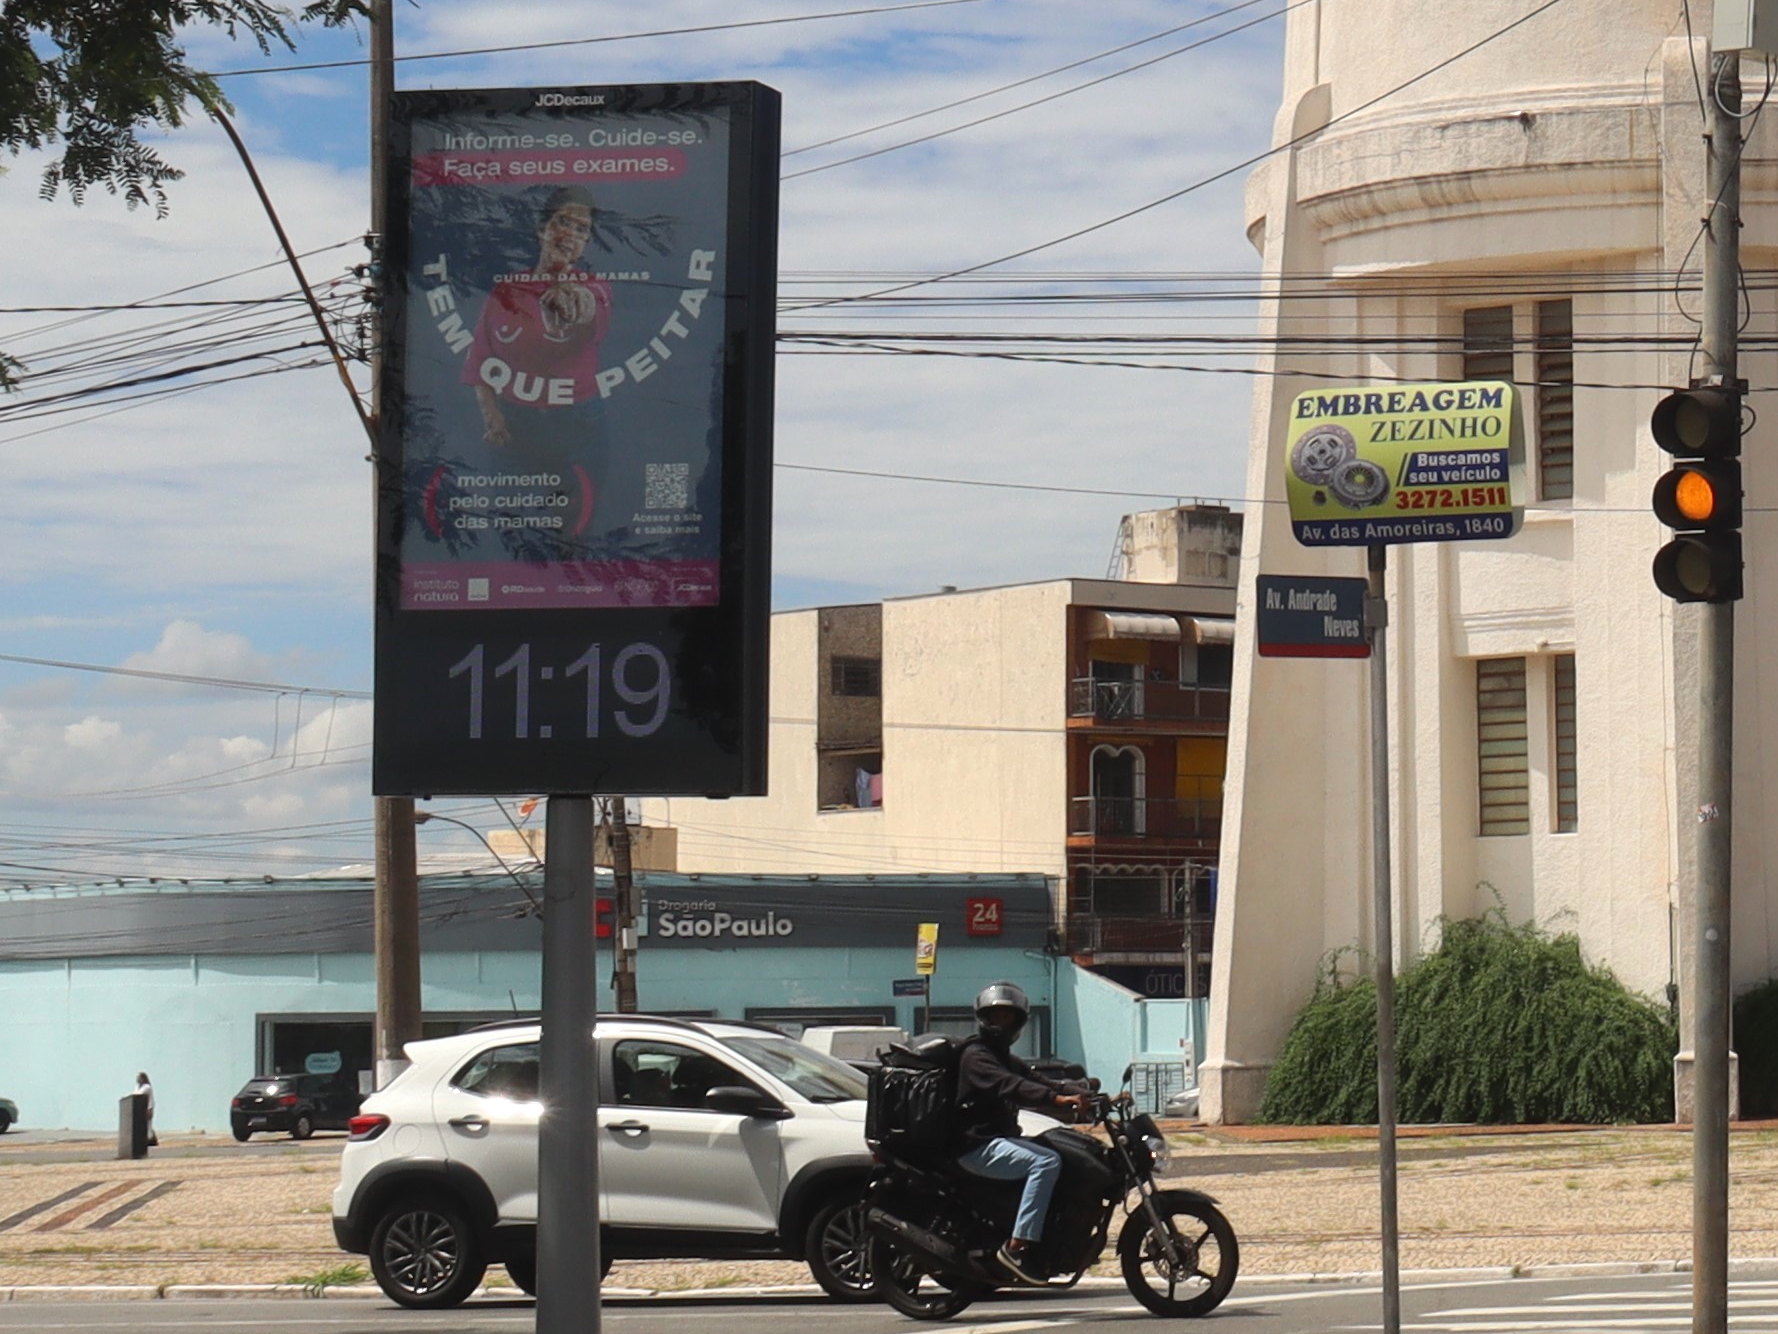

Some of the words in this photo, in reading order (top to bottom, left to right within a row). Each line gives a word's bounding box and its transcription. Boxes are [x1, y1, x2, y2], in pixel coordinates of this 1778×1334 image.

[534, 93, 605, 107] JCDecaux
[444, 132, 581, 151] Informe-se.
[588, 128, 703, 148] Cuide-se.
[443, 157, 501, 178] Faça
[508, 159, 565, 175] seus
[572, 156, 675, 174] exames.
[493, 272, 550, 284] CUIDAR
[557, 272, 589, 282] DAS
[595, 270, 651, 281] MAMAS
[422, 253, 476, 354] TEM
[479, 356, 575, 406] QUE
[595, 248, 717, 400] PEITAR
[1294, 387, 1505, 419] EMBREAGEM
[1369, 415, 1503, 443] ZEZINHO
[1417, 450, 1501, 467] Buscamos
[456, 472, 561, 488] movimento
[1409, 469, 1438, 483] seu
[1441, 465, 1501, 482] veículo
[448, 493, 490, 512] pelo
[494, 492, 570, 508] cuidado
[1394, 486, 1507, 510] 3272.1511
[454, 514, 490, 529] das
[494, 515, 564, 530] mamas
[1301, 525, 1326, 541] Av.
[1329, 524, 1360, 540] das
[1364, 519, 1461, 539] Amoreiras,
[1464, 518, 1504, 534] 1840
[1265, 587, 1285, 610] Av.
[1287, 588, 1338, 612] Andrade
[1323, 615, 1360, 638] Neves
[448, 642, 672, 739] 11:19
[658, 899, 717, 912] Drogaria
[973, 902, 998, 922] 24
[658, 910, 794, 938] SãoPaulo
[1145, 968, 1207, 995] ÓTICS
